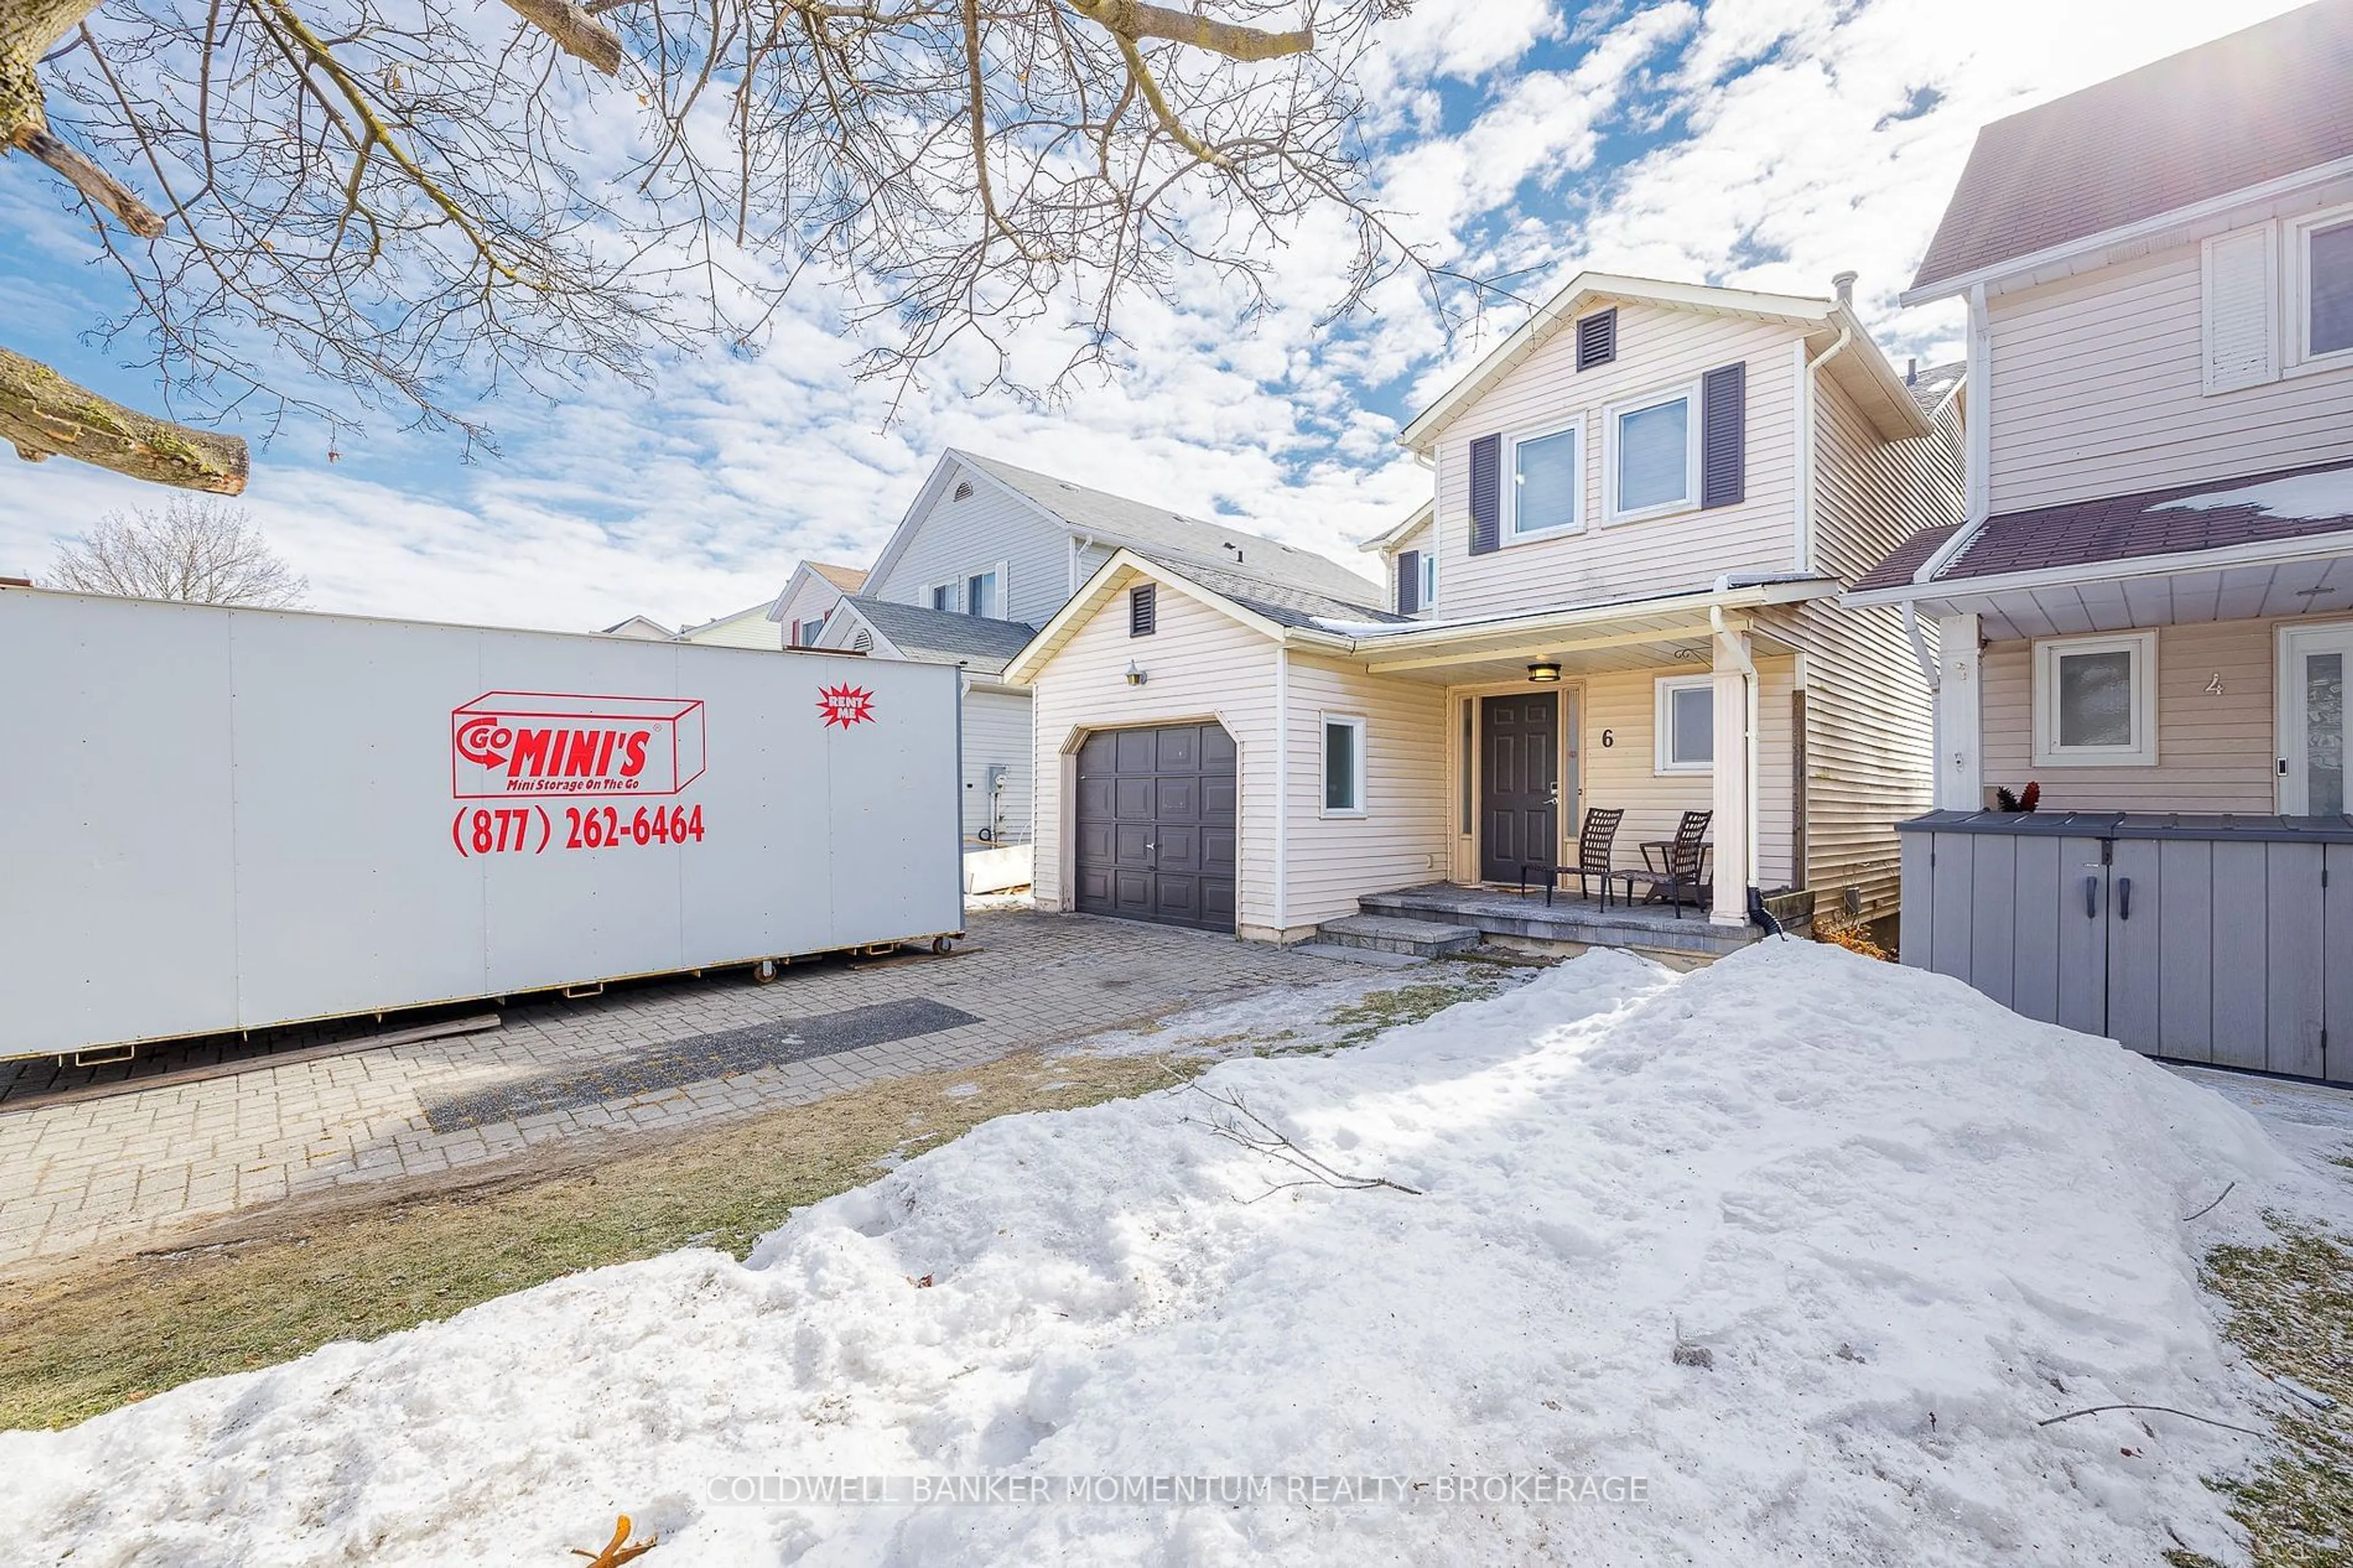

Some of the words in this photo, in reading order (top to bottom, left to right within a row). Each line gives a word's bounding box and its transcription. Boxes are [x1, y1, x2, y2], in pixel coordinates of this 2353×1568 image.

[2205, 673, 2224, 695] 4
[828, 696, 864, 708] RENT
[837, 707, 856, 719] ME
[1602, 729, 1614, 748] 6
[507, 729, 651, 777] MINI'S
[507, 779, 534, 790] Mini
[536, 779, 584, 791] Storage
[586, 779, 601, 790] On
[604, 779, 624, 789] The
[625, 779, 639, 789] Go
[452, 806, 550, 857] (877)
[566, 804, 705, 849] 262-6464
